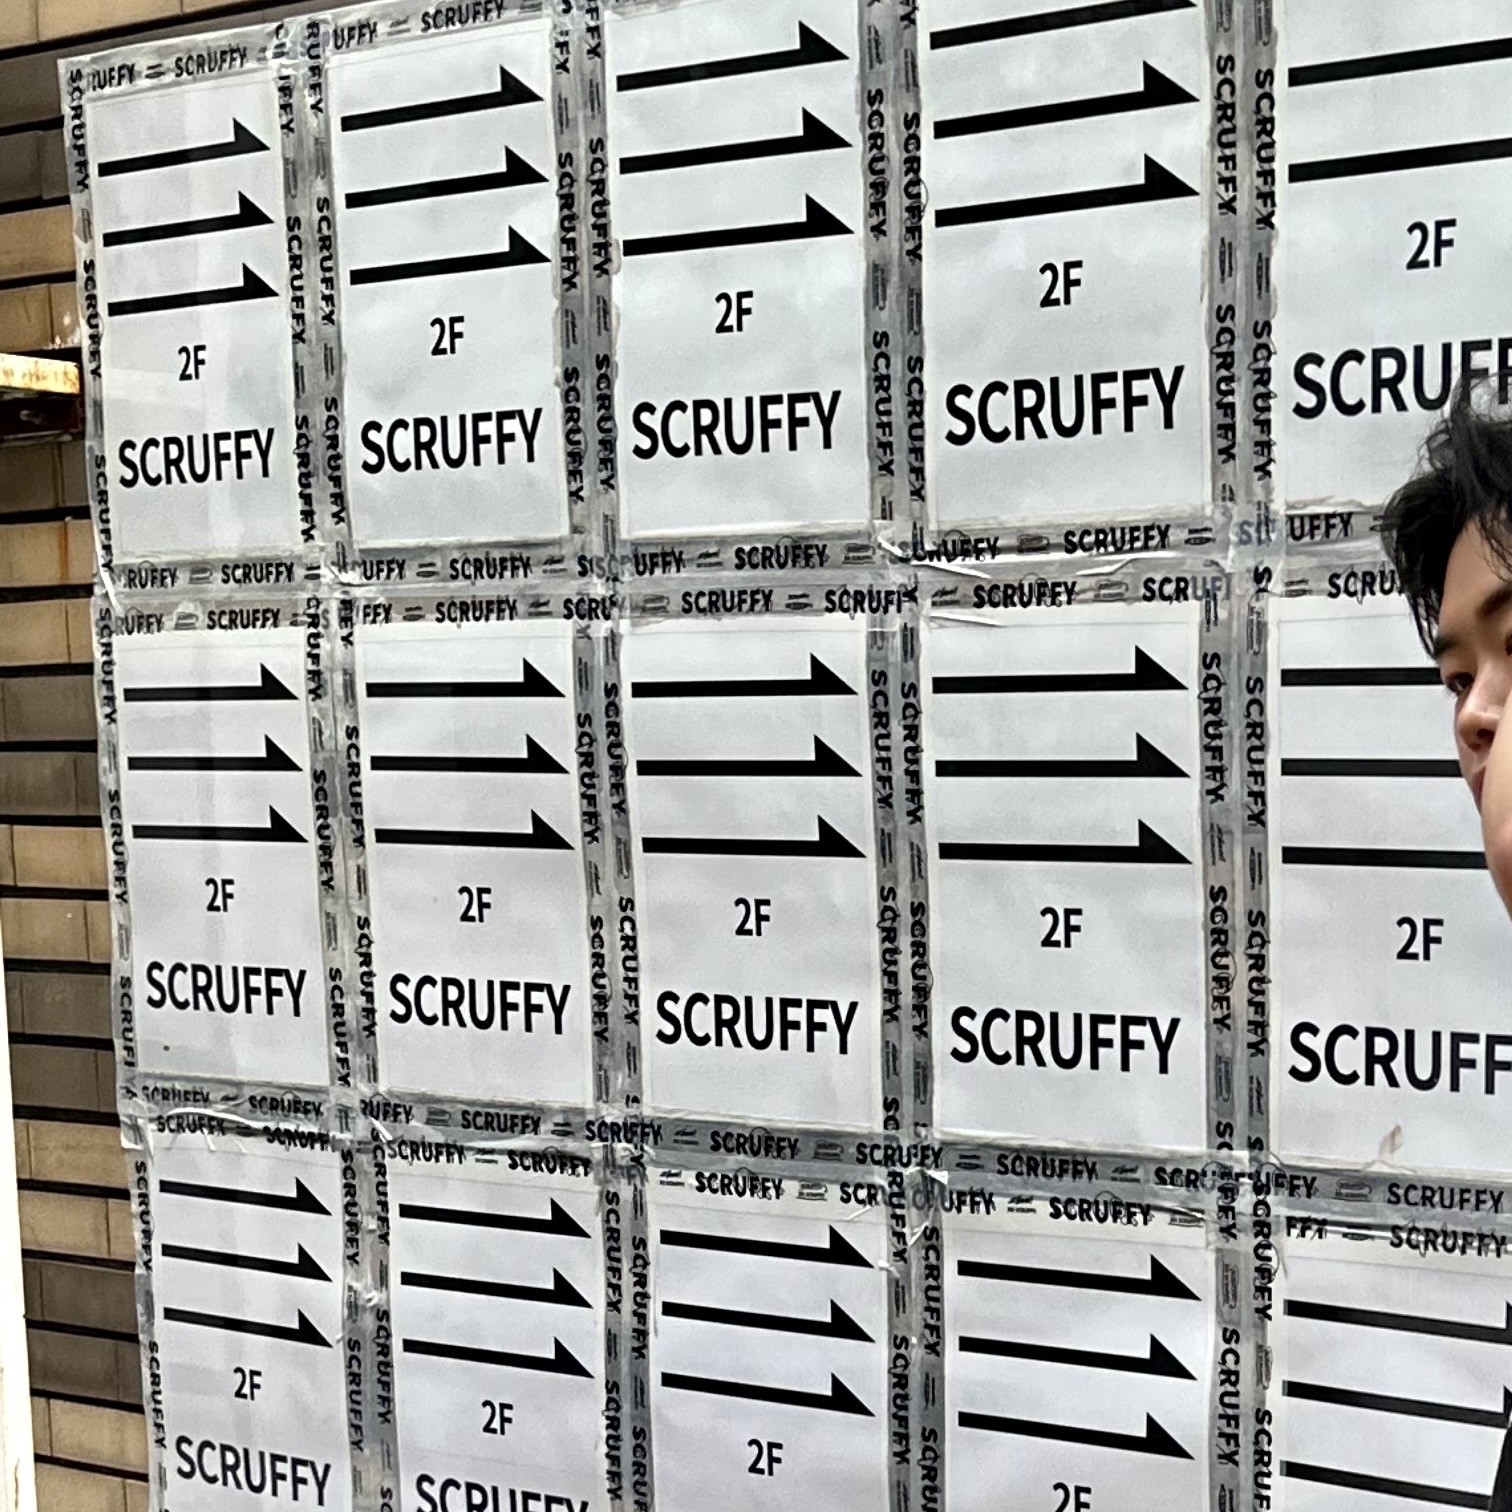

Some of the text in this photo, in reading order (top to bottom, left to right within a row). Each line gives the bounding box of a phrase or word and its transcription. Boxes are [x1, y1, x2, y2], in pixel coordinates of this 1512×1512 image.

[1406, 219, 1456, 270] 2F
[1040, 260, 1082, 307] 2F
[716, 291, 753, 333] 2F
[430, 316, 464, 355] 2F
[178, 345, 206, 381] 2F
[633, 390, 841, 459] SCRUFFY
[946, 365, 1184, 445] SCRUFFY
[119, 428, 274, 488] SCRUFFY
[361, 408, 542, 474] SCRUFFY
[206, 878, 234, 912] 2F
[458, 886, 491, 923] 2F
[735, 898, 770, 936] 2F
[1040, 907, 1082, 948] 2F
[1397, 917, 1443, 960] 2F
[147, 961, 306, 1017] SCRUFFY
[390, 974, 571, 1034] SCRUFFY
[656, 991, 858, 1054] SCRUFFY
[950, 1006, 1180, 1074] SCRUFFY
[234, 1367, 261, 1400] 2F
[482, 1400, 513, 1435] 2F
[176, 1436, 331, 1506] SCRUFFY
[748, 1439, 783, 1476] 2F
